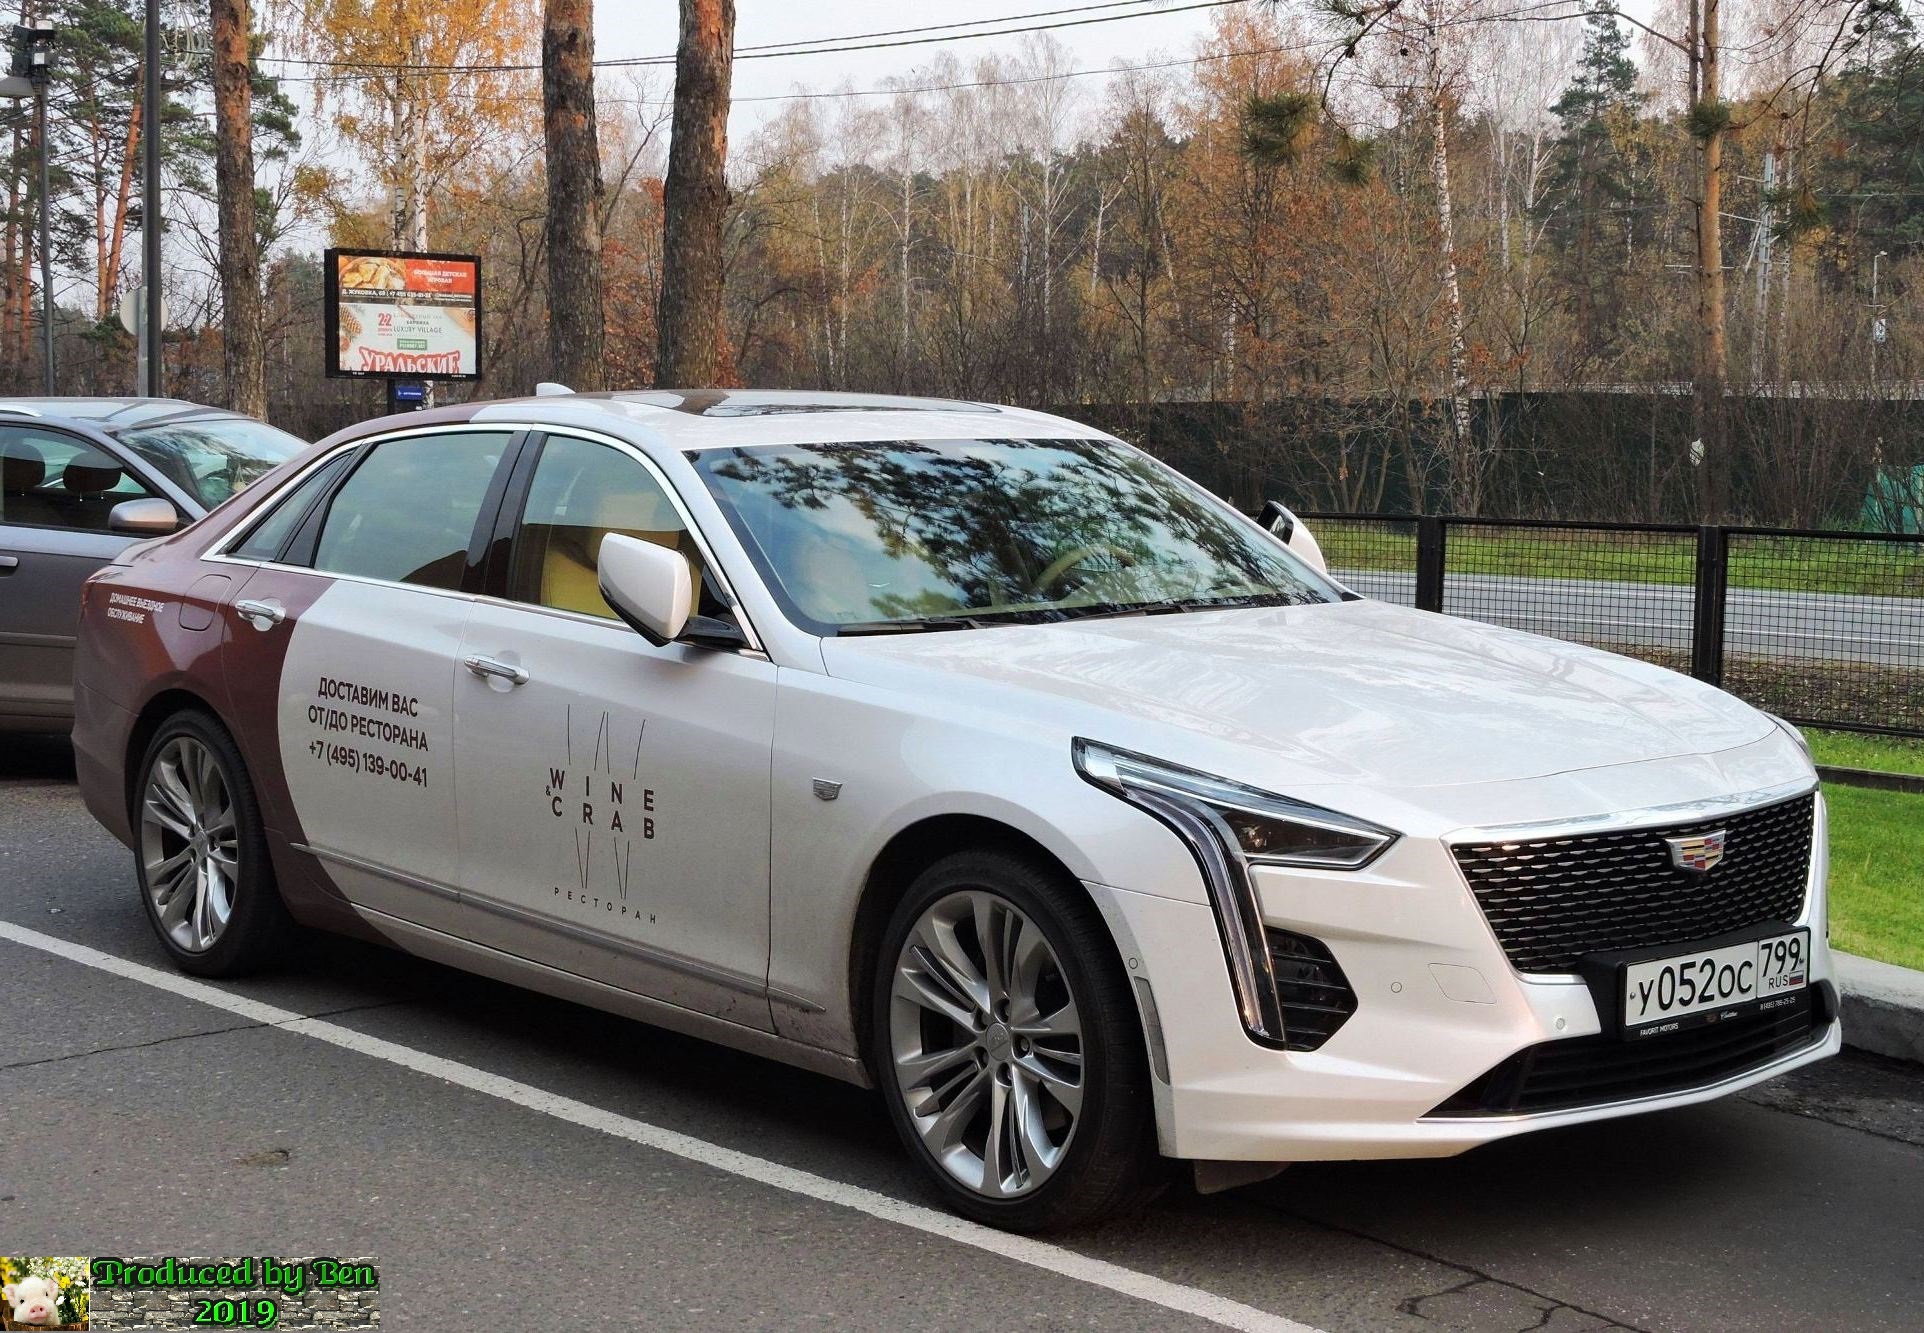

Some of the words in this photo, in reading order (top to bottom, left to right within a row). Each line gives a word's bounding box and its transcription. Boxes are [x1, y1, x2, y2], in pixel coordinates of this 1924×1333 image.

[378, 312, 393, 327] 22
[393, 325, 416, 333] LUXURY
[417, 326, 442, 334] VILLAGE
[359, 347, 460, 373] УРАЛЬСКИЕ
[109, 592, 138, 606] ДОМАШНЕЕ
[107, 607, 145, 624] ОБСЛУЖИВАНИЕ
[318, 677, 389, 711] ДОСТАВИМ
[391, 693, 418, 718] ВАС
[308, 704, 348, 732] ОТ/ДО
[350, 713, 429, 752] РЕСТОРАНА
[309, 740, 324, 760] +7
[326, 742, 360, 774] (495)
[362, 752, 428, 788] 139-00-41
[550, 768, 654, 812] WINE
[551, 796, 655, 840] CRAB
[554, 887, 656, 924] РЕСТОРАН
[1760, 937, 1801, 978] 799
[1768, 974, 1789, 990] RUS
[1640, 1026, 1659, 1037] FAVORIT
[1659, 1022, 1679, 1033] MOTORS
